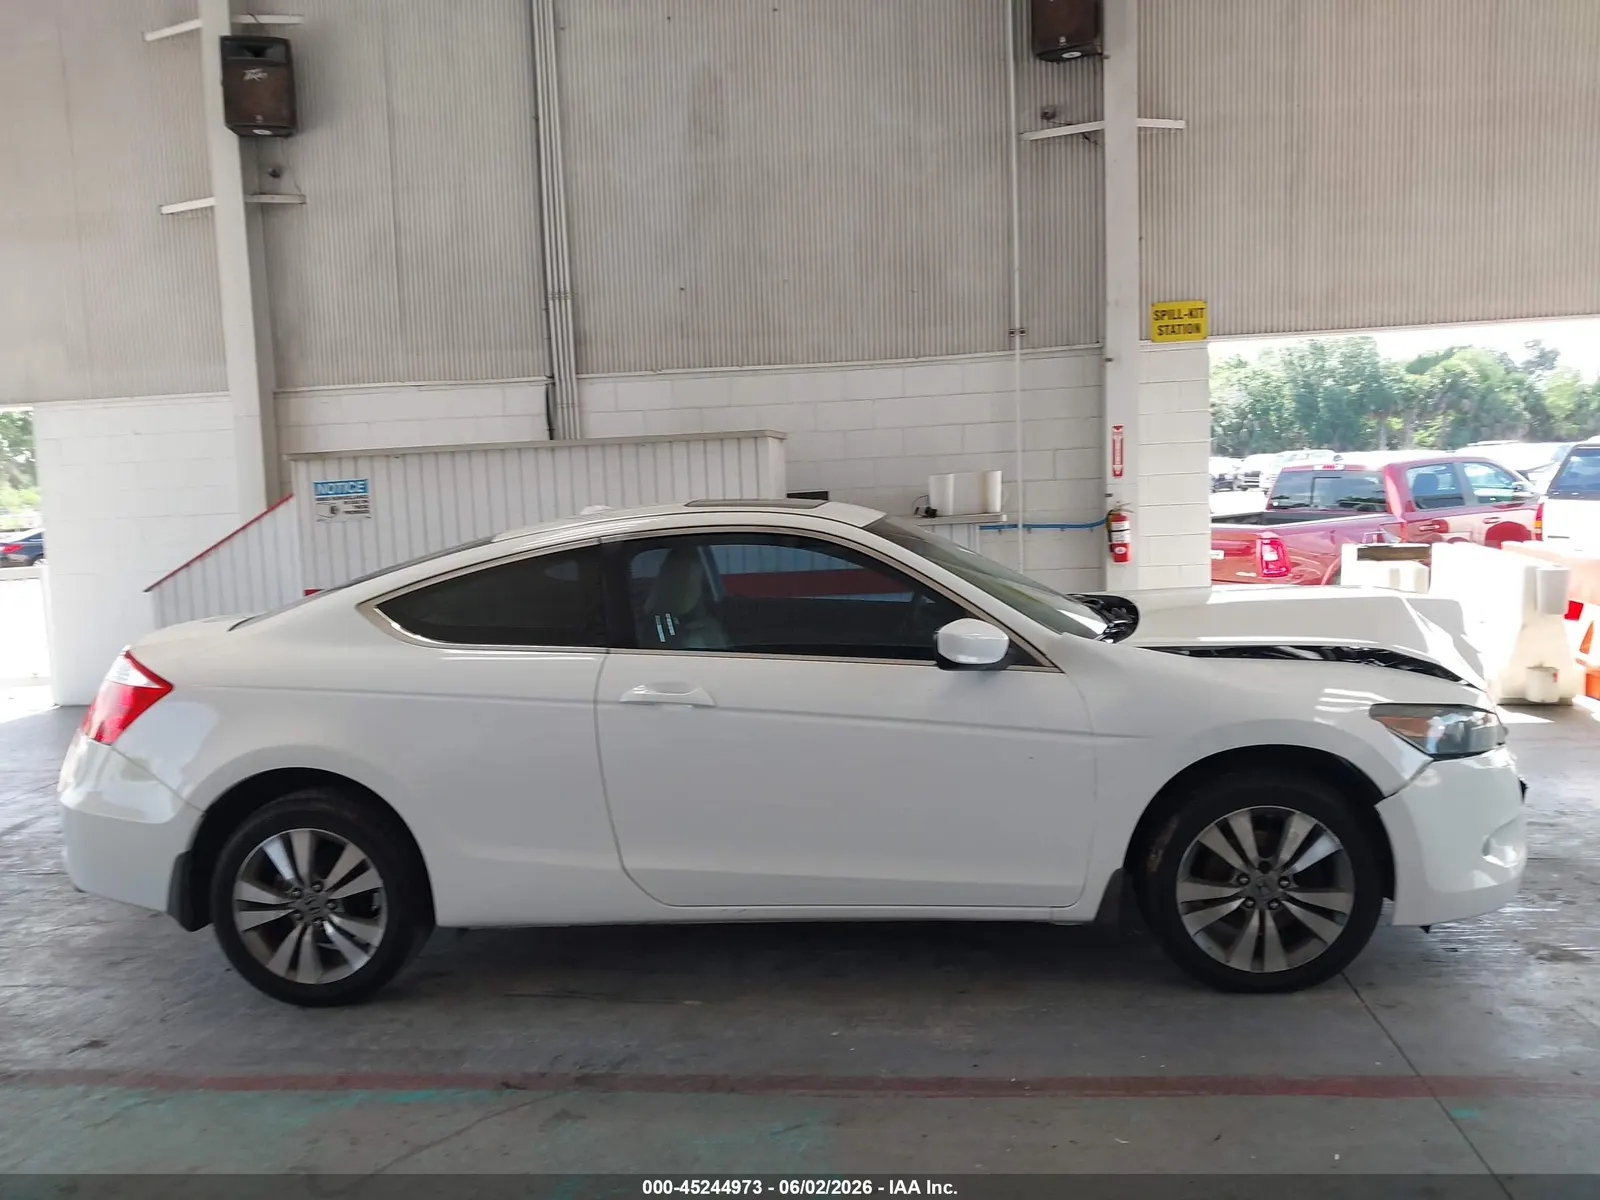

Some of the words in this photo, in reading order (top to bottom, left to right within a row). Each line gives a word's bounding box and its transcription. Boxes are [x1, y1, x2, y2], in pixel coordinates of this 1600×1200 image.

[1153, 307, 1204, 321] SPILL-KIT
[1157, 323, 1202, 336] STATION
[315, 482, 366, 494] NOTICE
